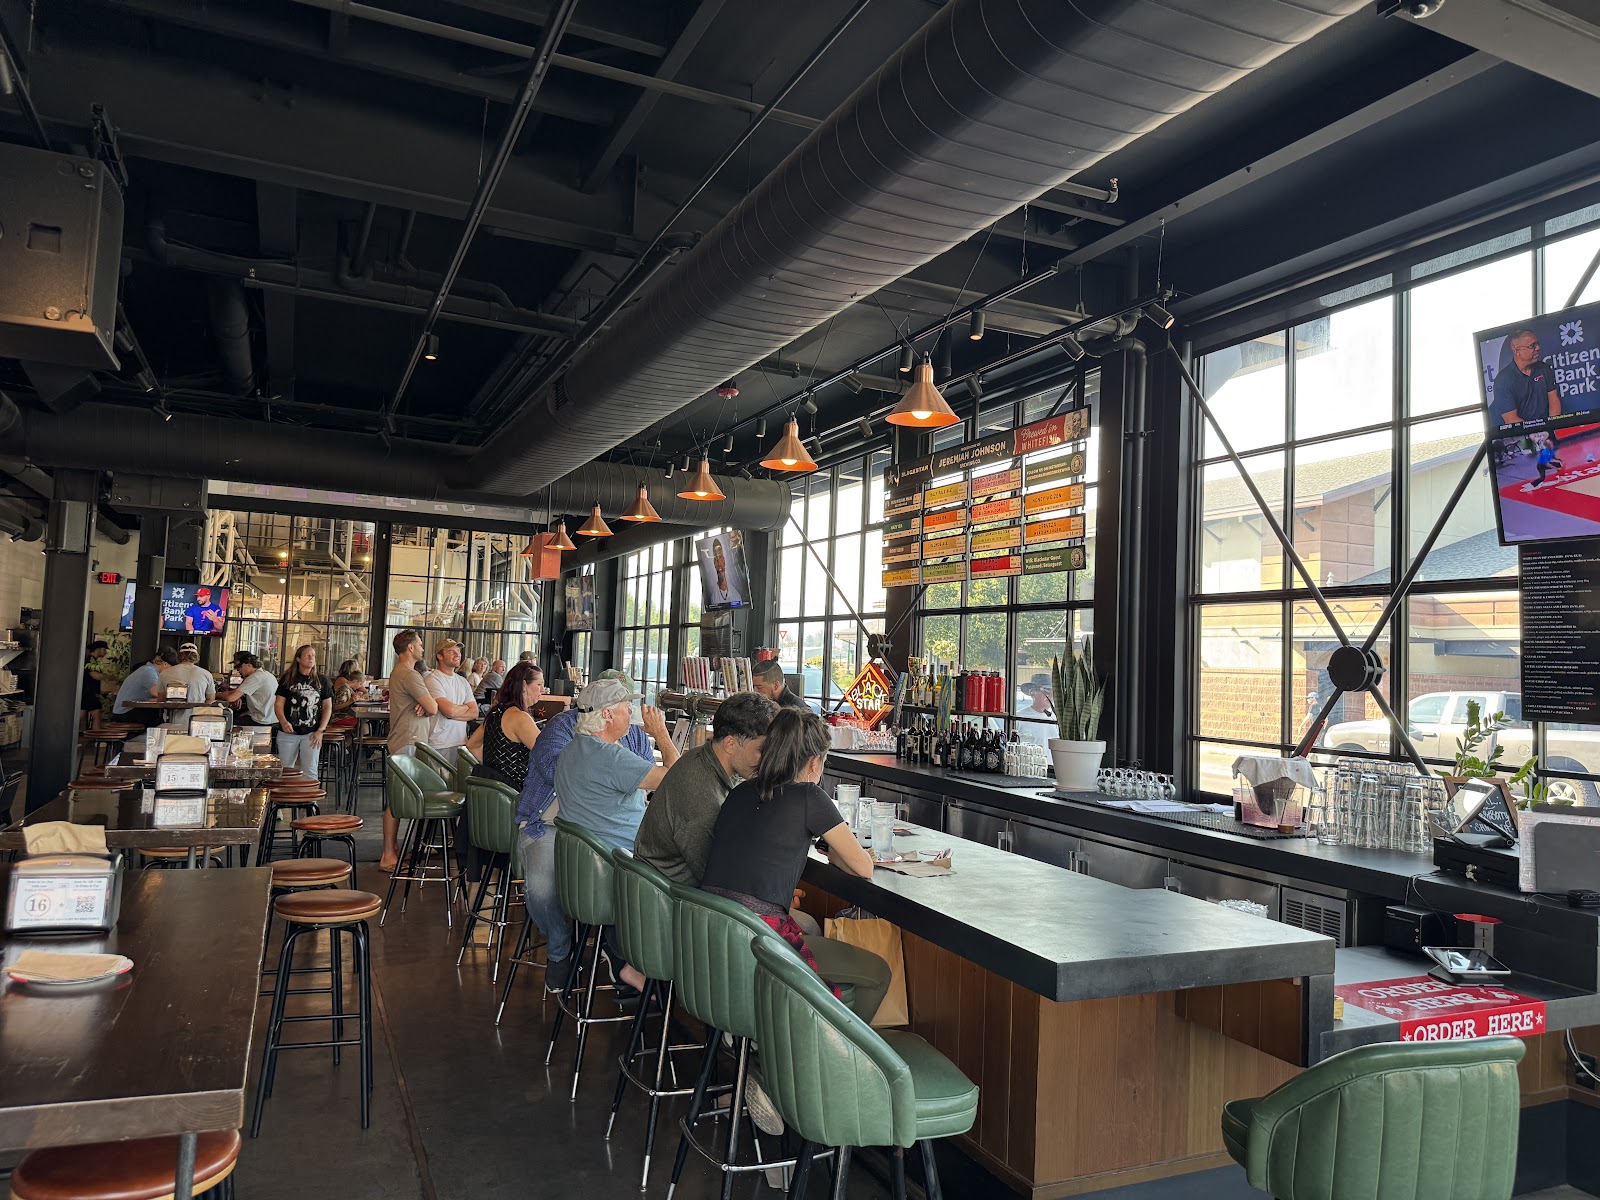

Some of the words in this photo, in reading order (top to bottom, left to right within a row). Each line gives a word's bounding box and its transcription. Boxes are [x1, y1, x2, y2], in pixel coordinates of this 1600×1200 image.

[1554, 362, 1597, 384] Bank
[1559, 377, 1597, 398] Park
[938, 451, 971, 468] JEREMIAH
[971, 441, 1006, 459] JOHNSON
[101, 573, 117, 584] EXIT
[164, 607, 186, 616] Bank
[164, 614, 184, 622] Park
[856, 698, 881, 710] STAR
[28, 899, 46, 912] 16
[1358, 981, 1461, 999] ORDER
[1400, 993, 1488, 1010] HERE
[1413, 1019, 1477, 1042] ORDER
[1487, 1010, 1534, 1036] HERE
